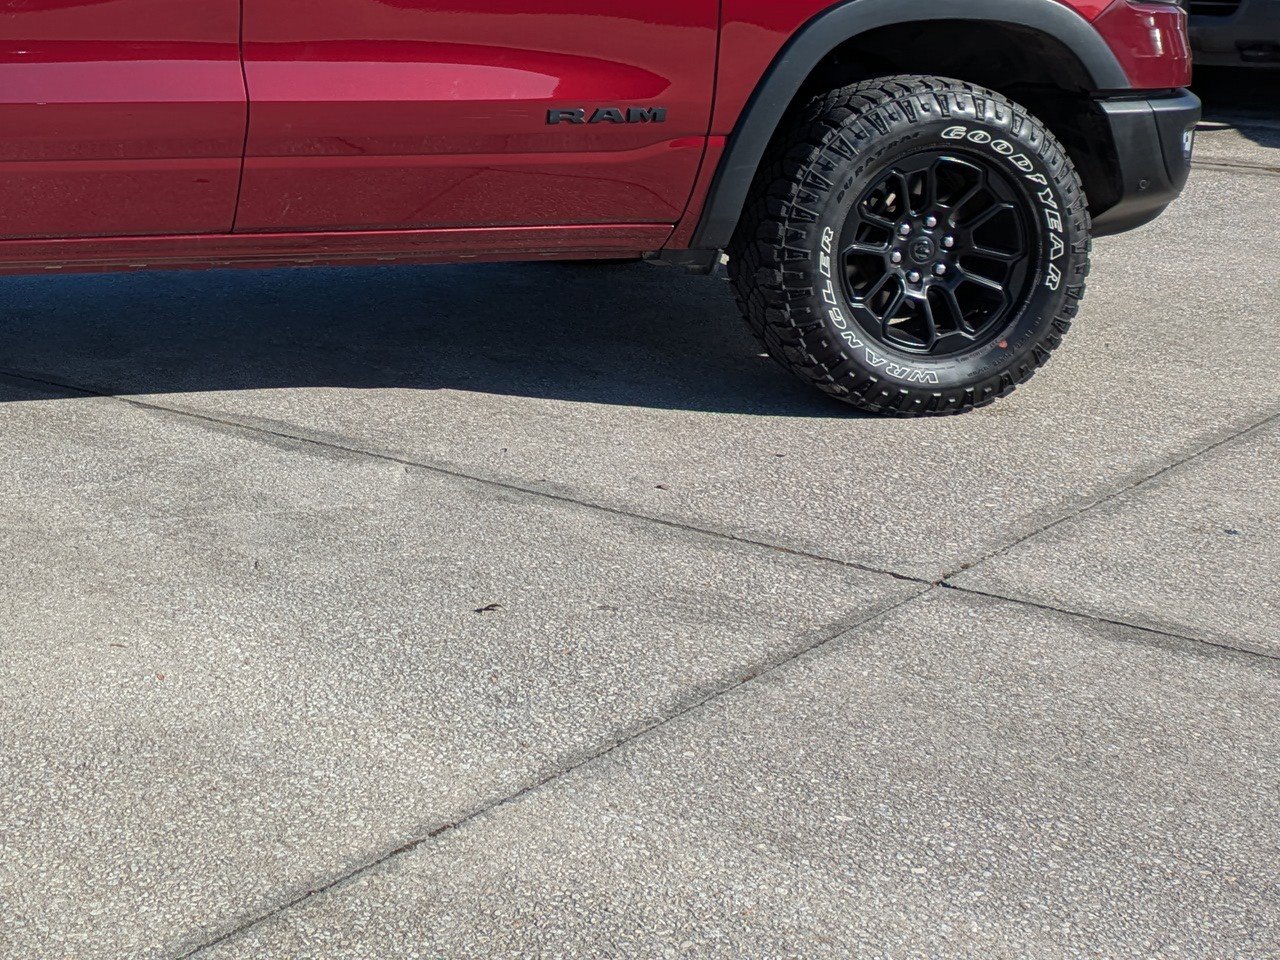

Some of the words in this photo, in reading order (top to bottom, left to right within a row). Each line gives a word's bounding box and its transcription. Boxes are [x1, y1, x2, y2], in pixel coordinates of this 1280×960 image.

[545, 106, 667, 126] RAM
[941, 126, 1064, 291] GOODYEAR
[819, 226, 939, 384] WRANGLER
